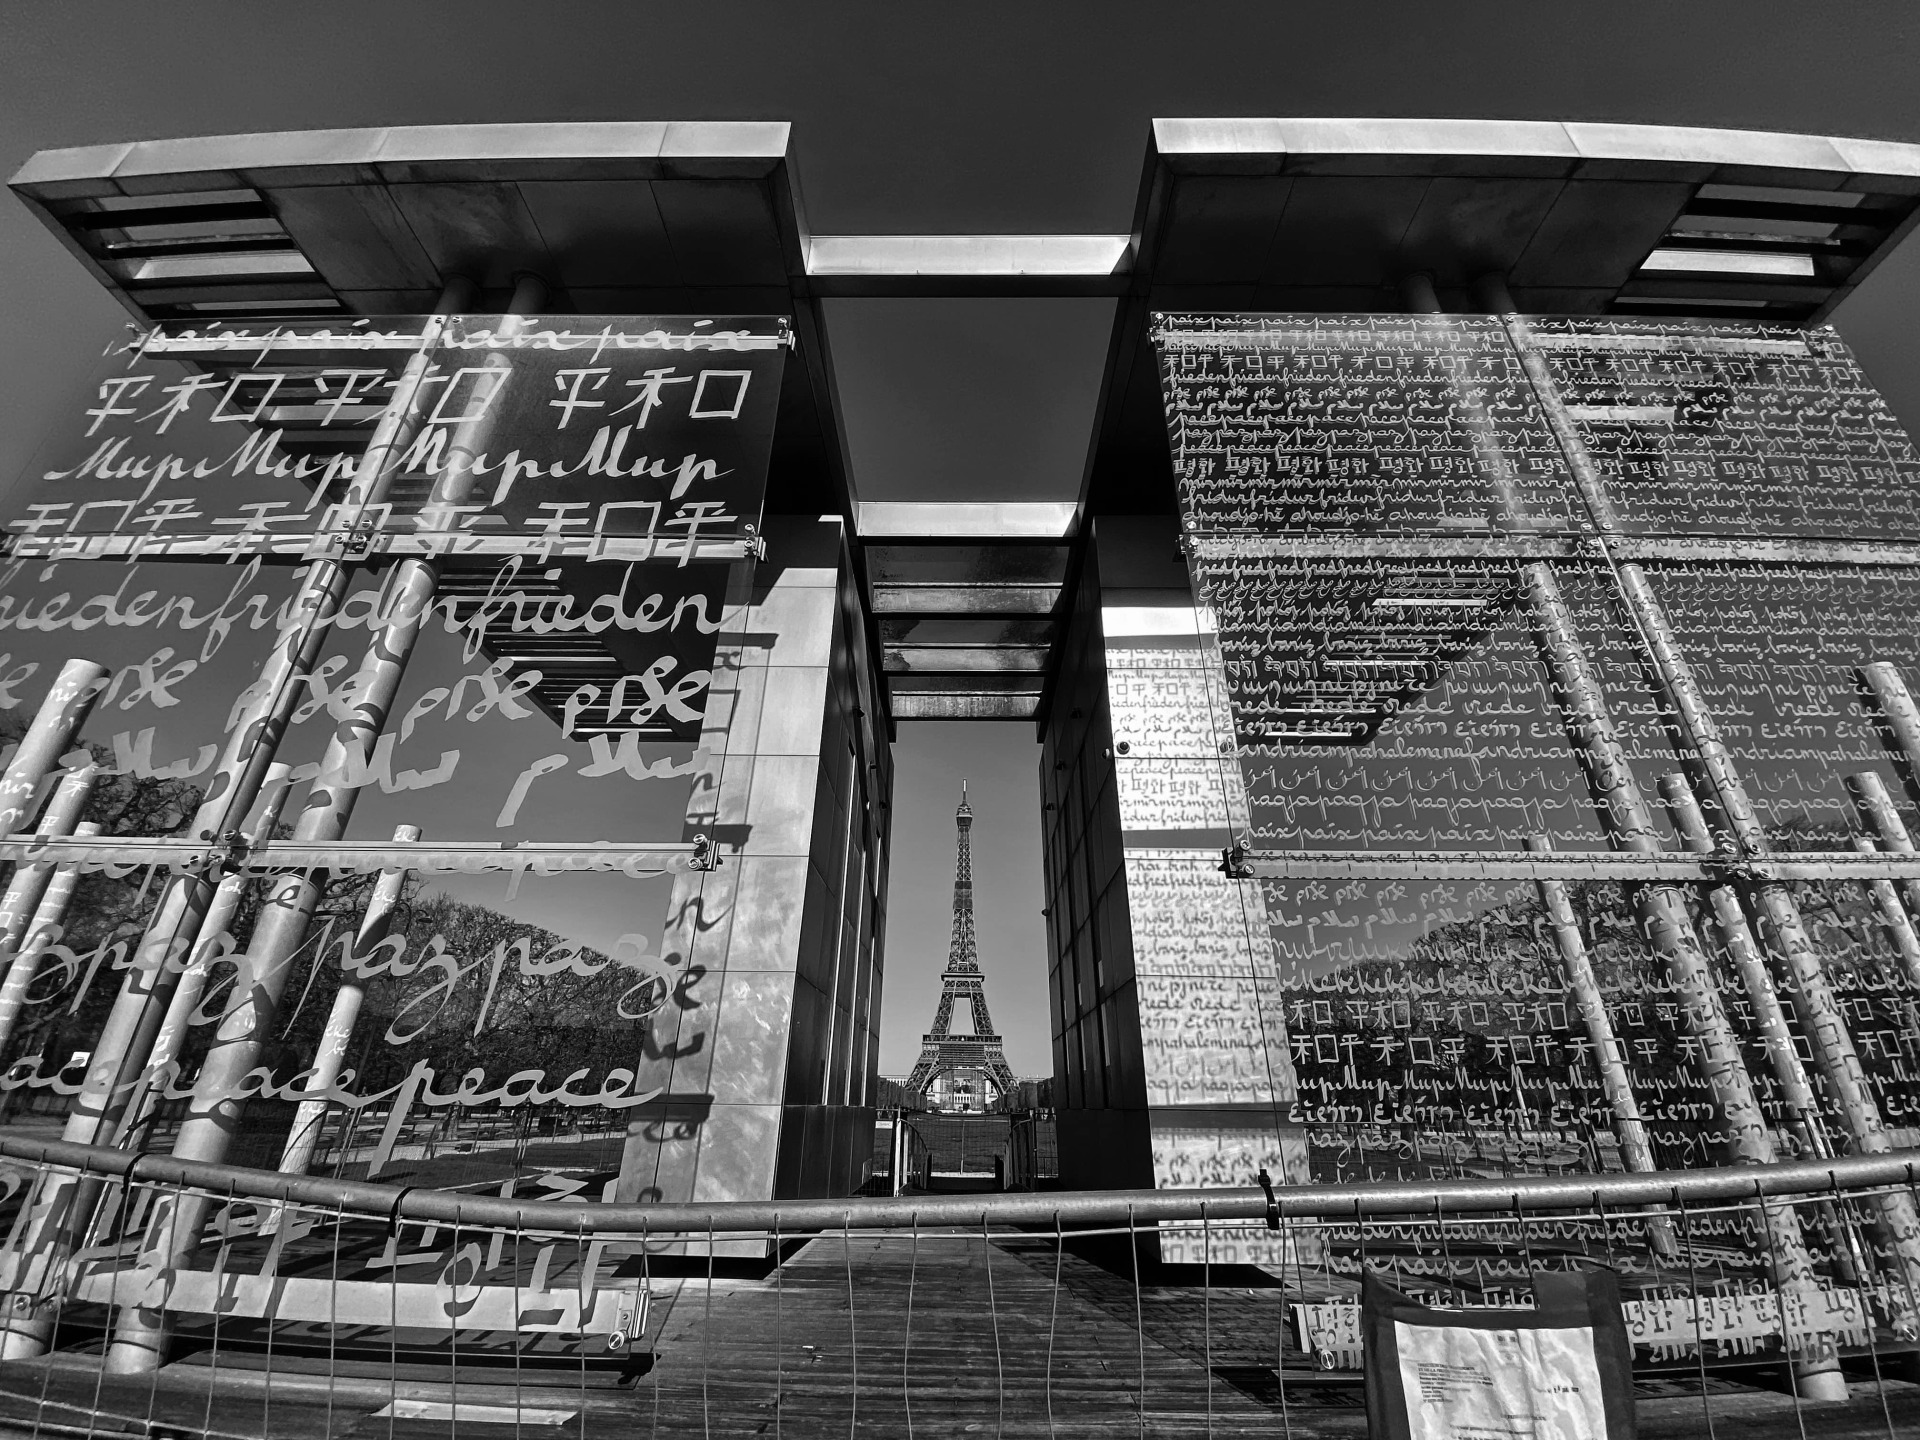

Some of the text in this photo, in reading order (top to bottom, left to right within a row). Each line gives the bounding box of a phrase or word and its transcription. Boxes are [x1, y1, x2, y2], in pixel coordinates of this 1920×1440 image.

[550, 367, 754, 430] 平和
[550, 424, 738, 500] Мир
[462, 553, 747, 664] frieden
[280, 917, 462, 1044] paz
[473, 932, 680, 1037] paz
[366, 1058, 664, 1179] peace
